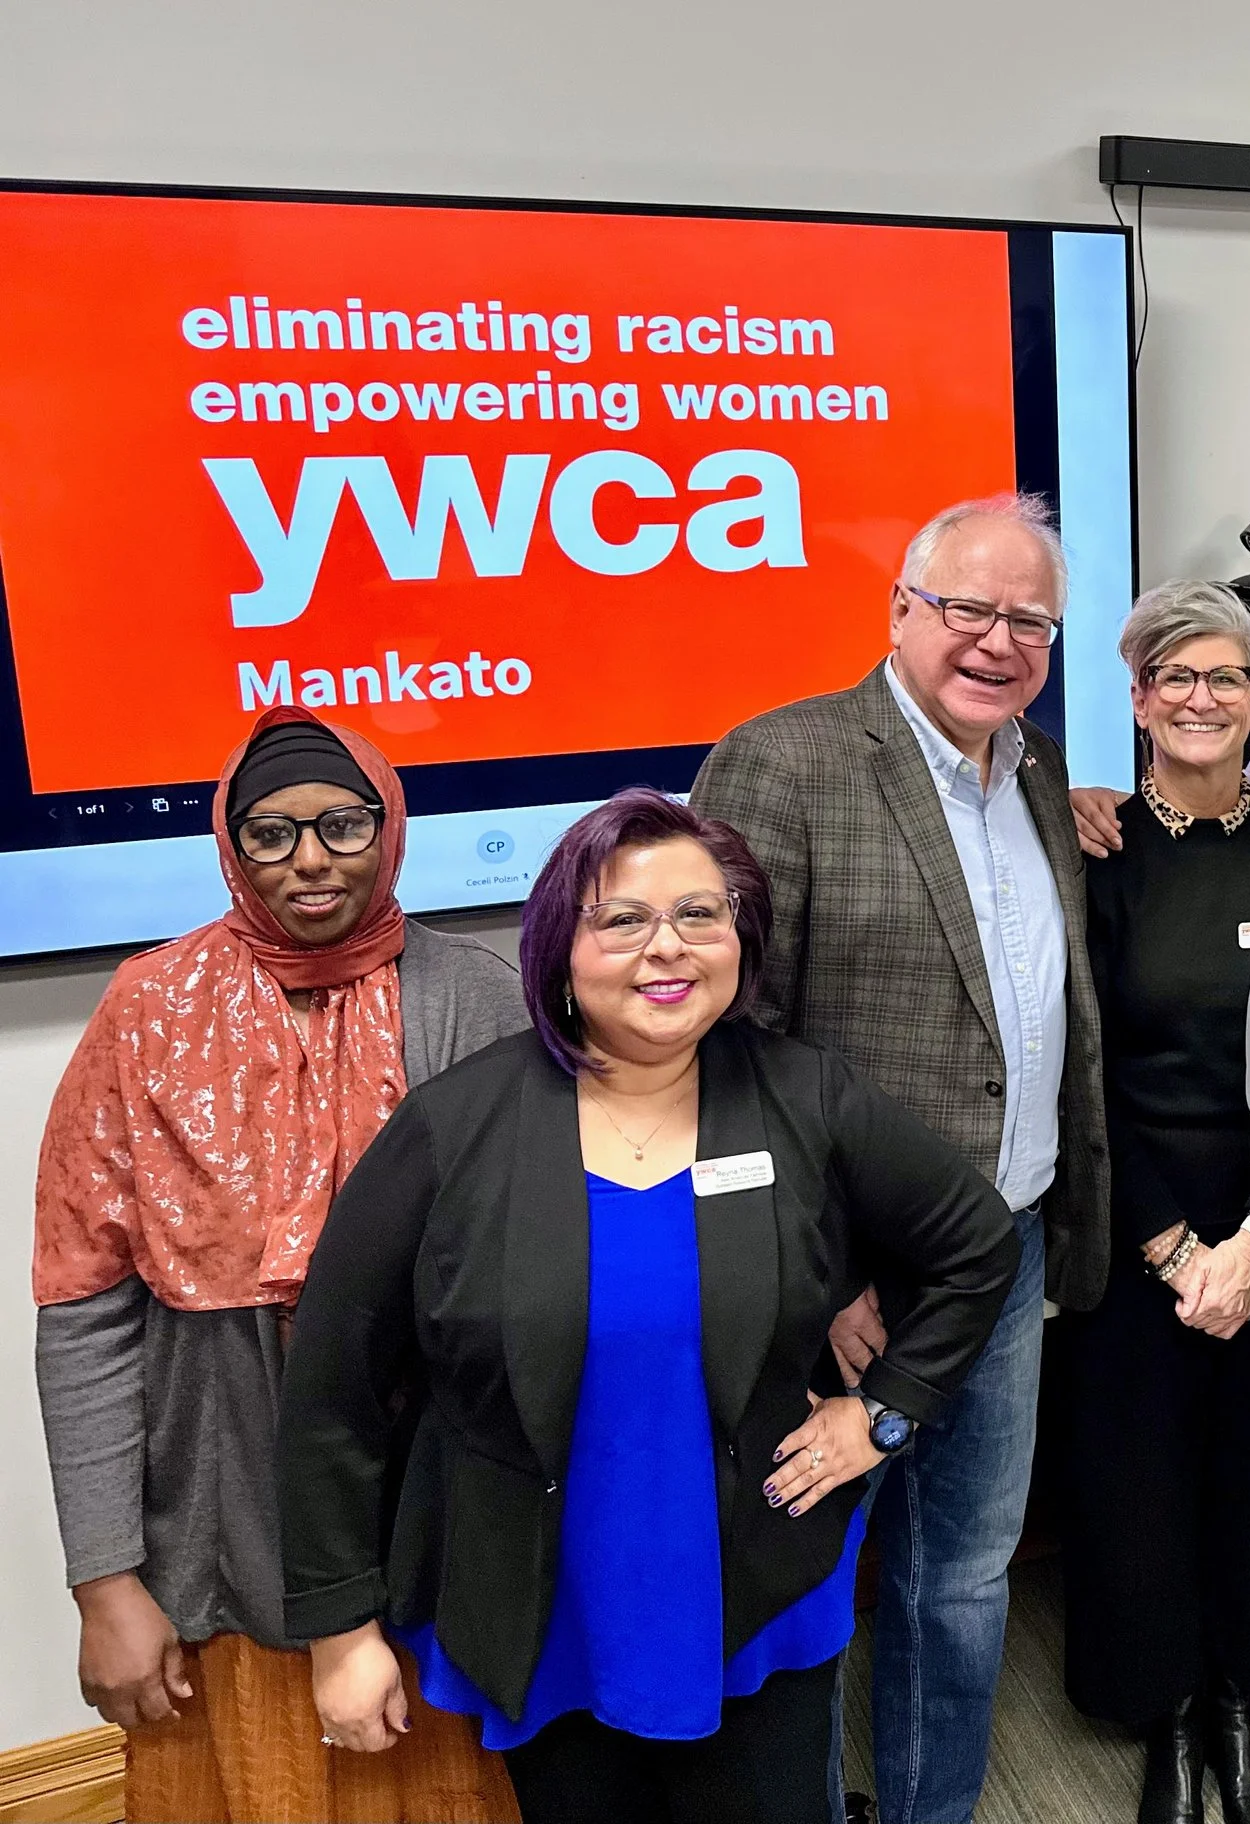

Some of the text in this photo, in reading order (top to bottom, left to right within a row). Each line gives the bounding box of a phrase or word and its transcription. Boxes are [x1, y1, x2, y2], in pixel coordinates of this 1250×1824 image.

[182, 296, 835, 364] eliminating racism
[190, 371, 889, 433] empowering women
[201, 448, 809, 629] ywca
[238, 650, 532, 712] Mankato
[76, 804, 105, 815] 1 of 1
[486, 841, 505, 853] CP
